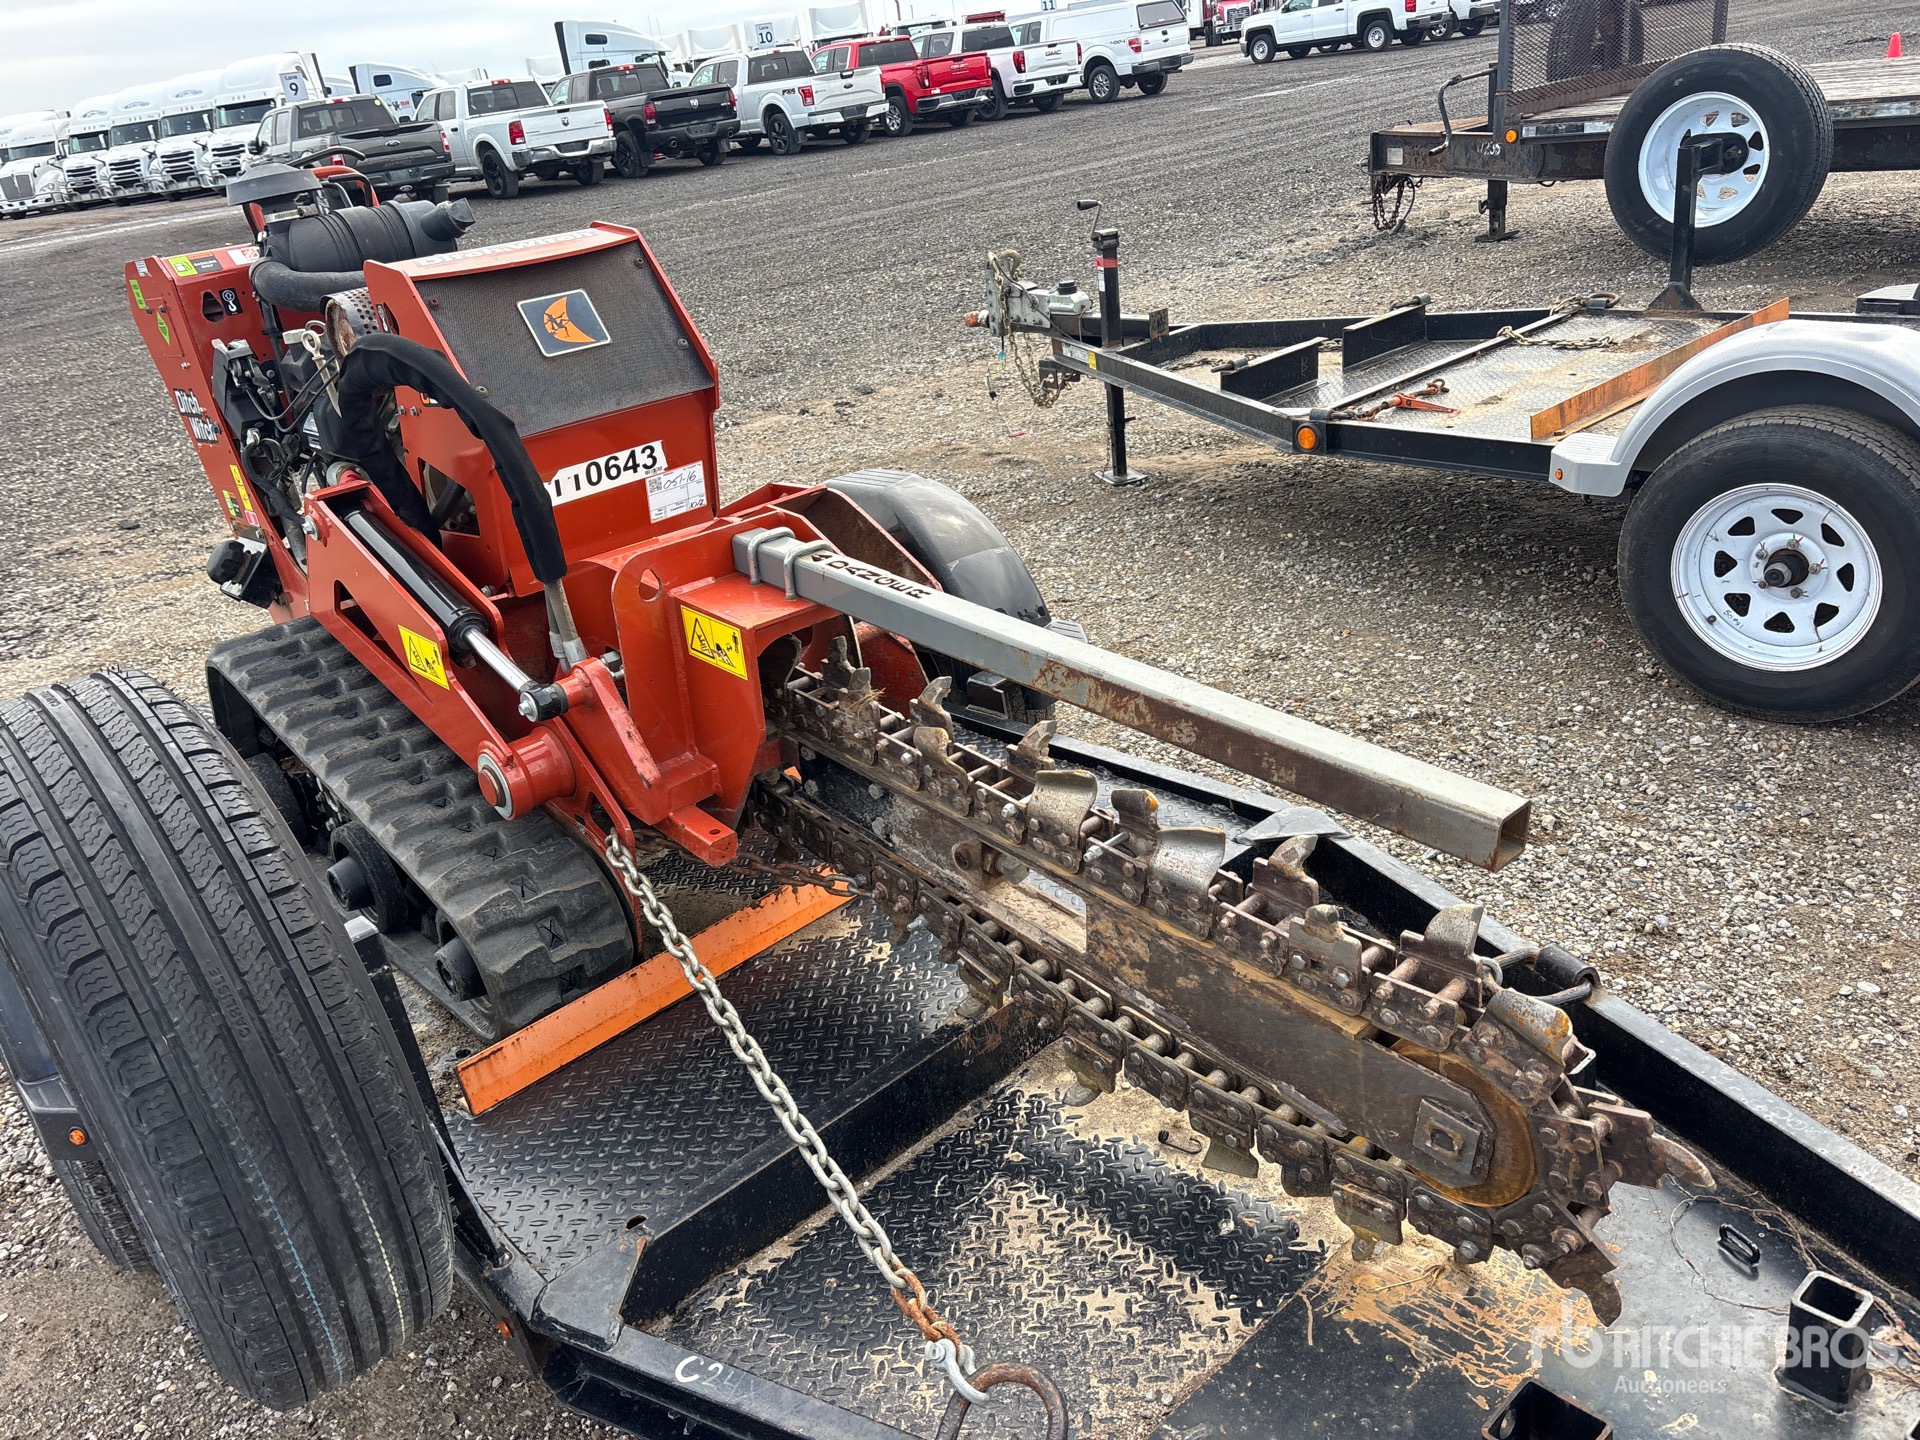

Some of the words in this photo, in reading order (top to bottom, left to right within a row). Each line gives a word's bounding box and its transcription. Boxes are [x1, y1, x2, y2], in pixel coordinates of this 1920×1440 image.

[758, 31, 773, 44] 10
[289, 82, 299, 96] 9
[174, 389, 202, 414] Ditch
[188, 416, 218, 441] Witch
[826, 560, 933, 599] DANGER
[208, 966, 251, 1038] CARLISLE
